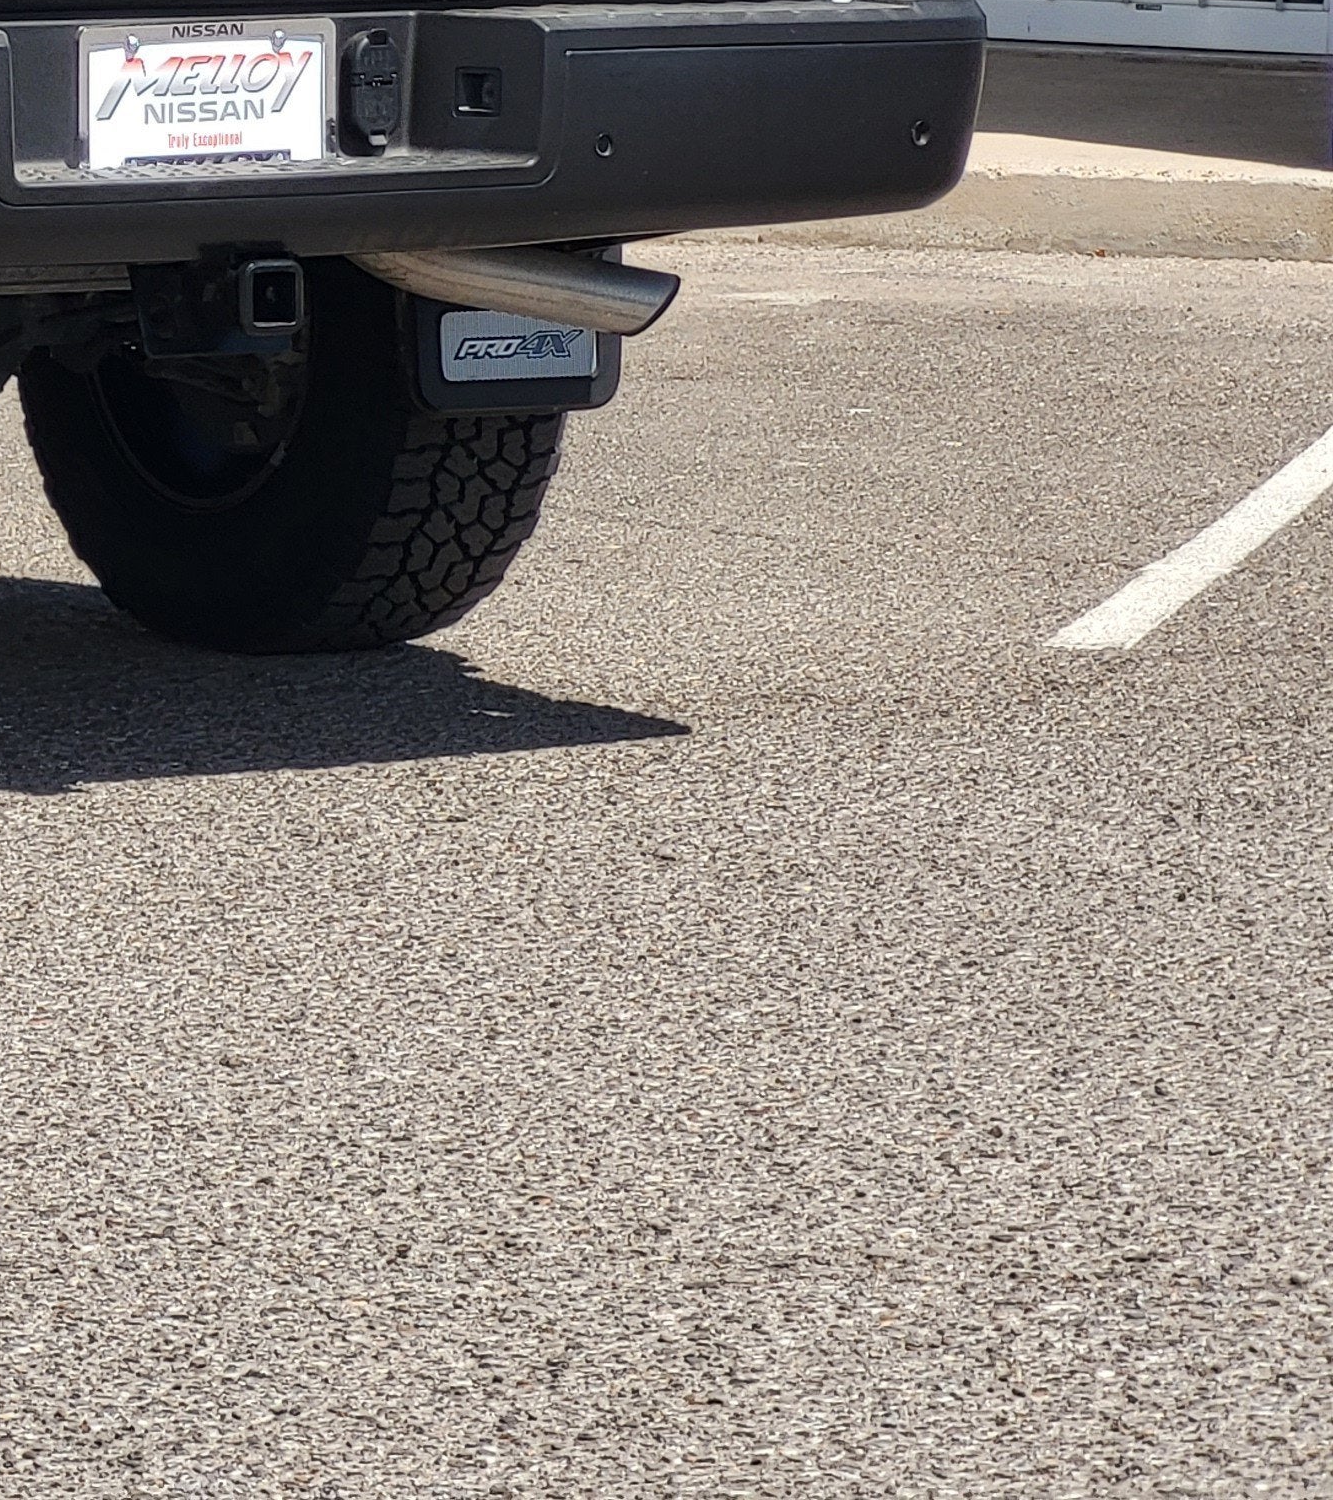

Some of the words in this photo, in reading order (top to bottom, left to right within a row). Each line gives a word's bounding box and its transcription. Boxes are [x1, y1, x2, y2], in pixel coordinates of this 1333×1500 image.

[172, 23, 244, 38] NISSAN
[96, 51, 313, 121] MELLOY
[144, 99, 264, 124] NISSAN
